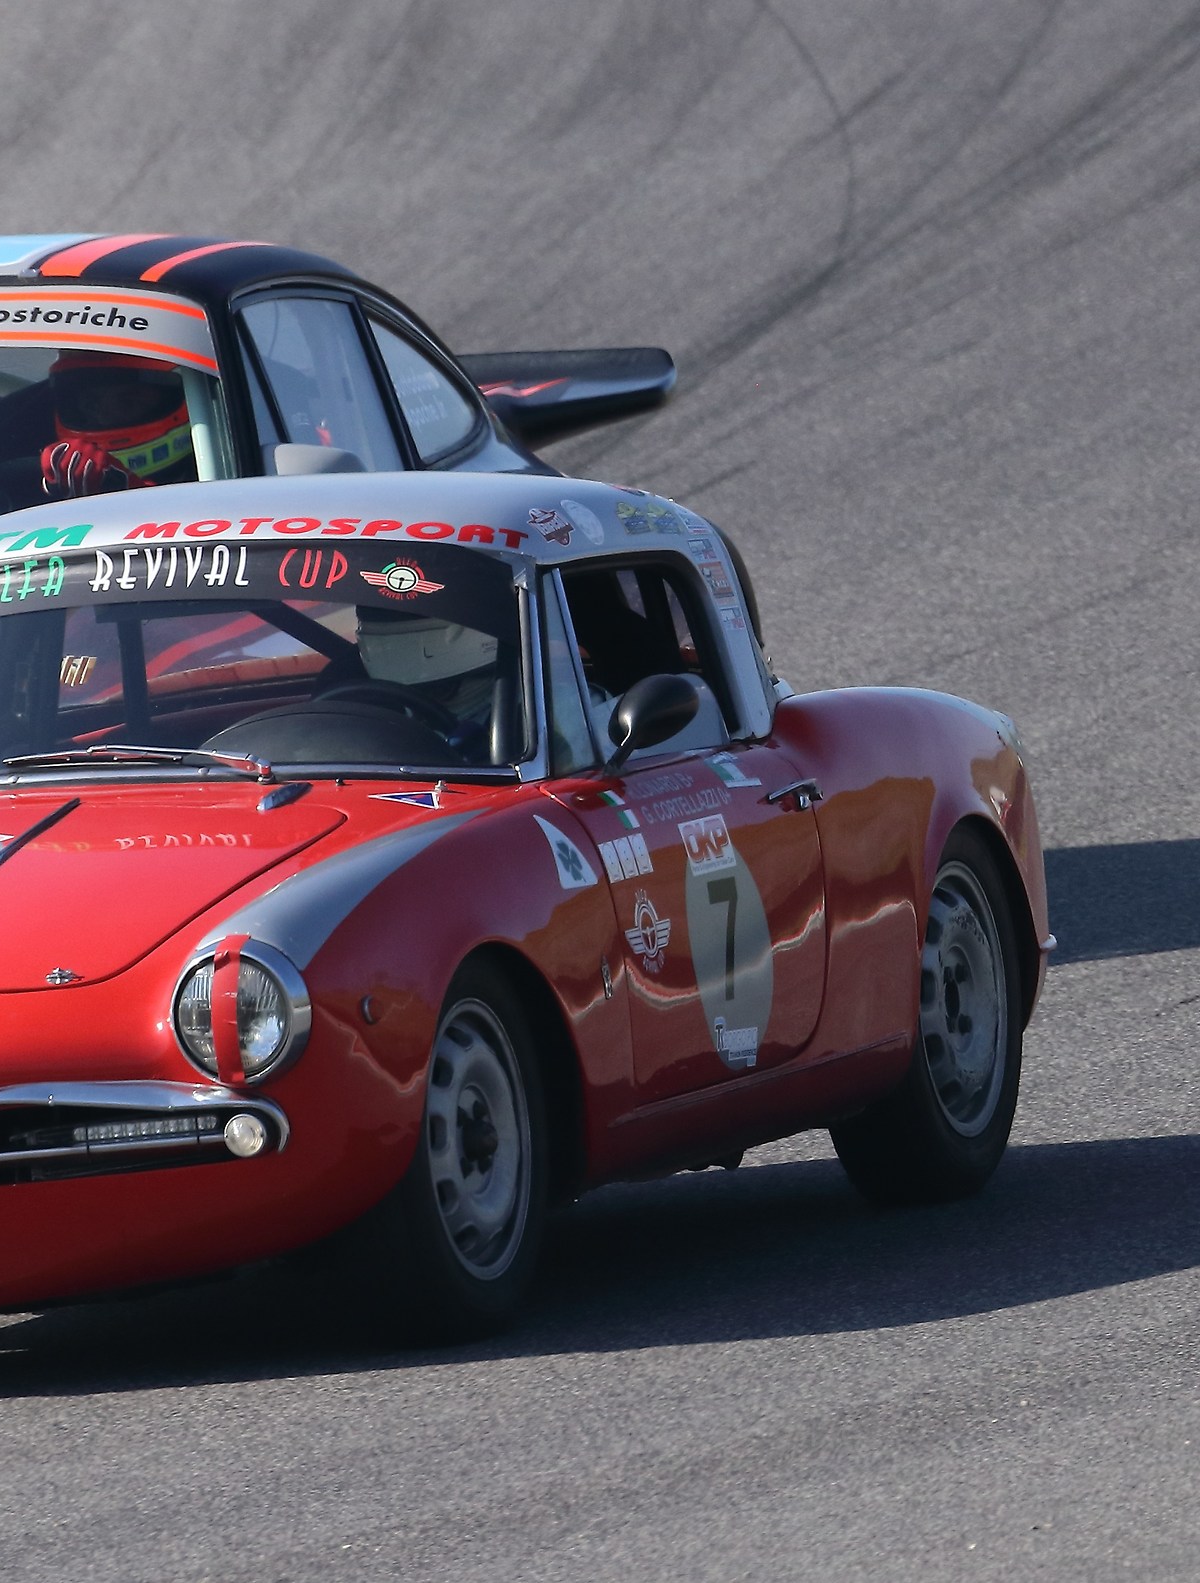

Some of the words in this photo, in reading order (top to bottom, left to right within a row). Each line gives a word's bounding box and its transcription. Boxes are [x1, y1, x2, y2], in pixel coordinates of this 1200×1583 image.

[122, 517, 529, 550] MOTOSPORT
[88, 544, 250, 592] REVIVAL
[278, 548, 349, 589] CUP
[707, 875, 738, 1001] 7
